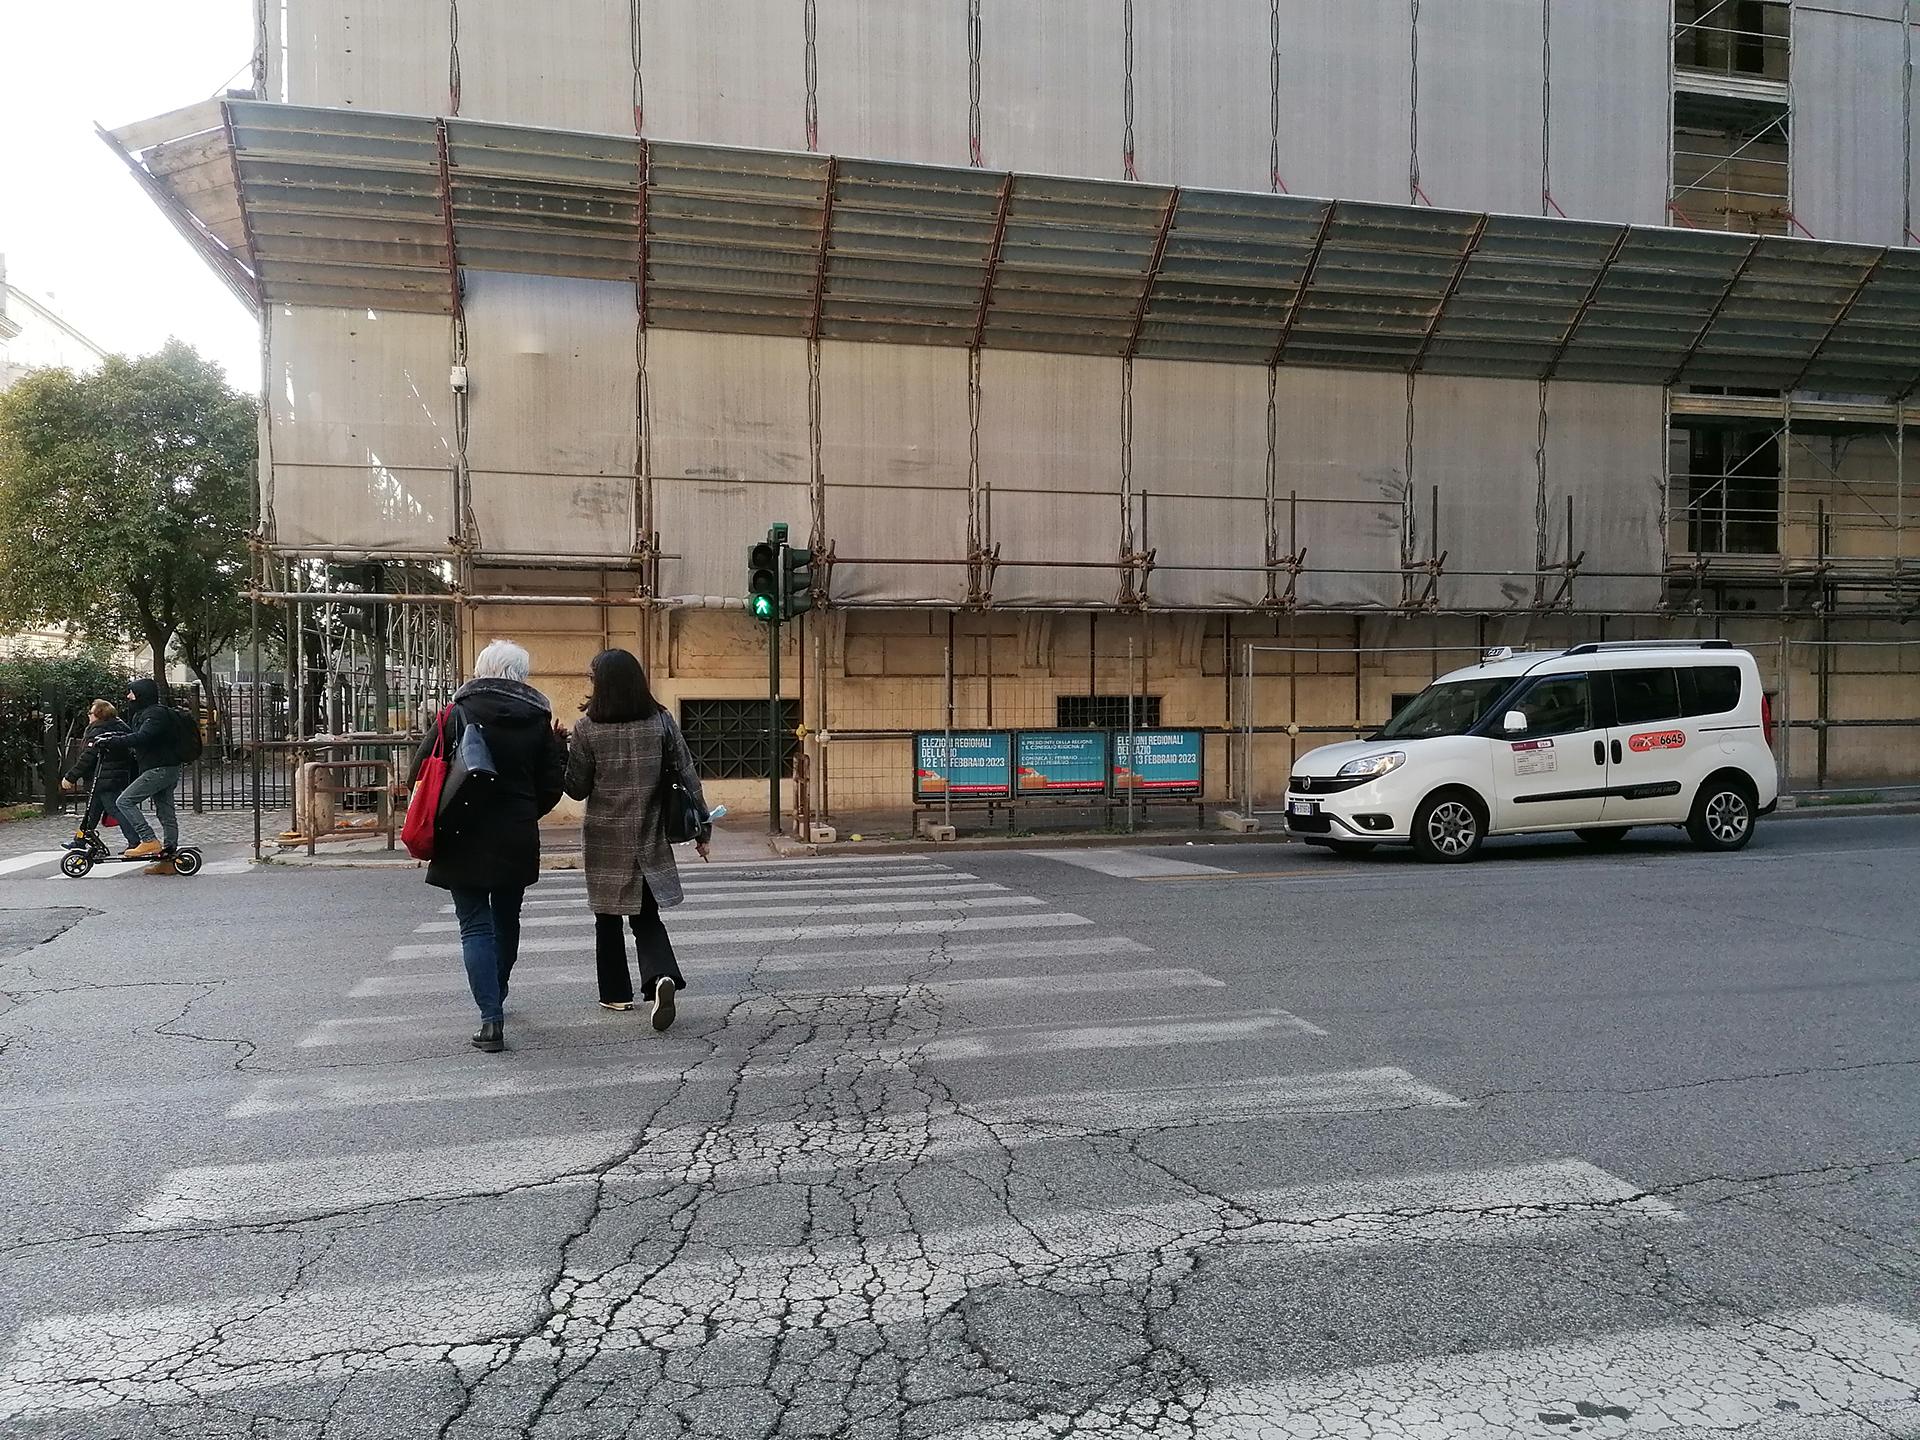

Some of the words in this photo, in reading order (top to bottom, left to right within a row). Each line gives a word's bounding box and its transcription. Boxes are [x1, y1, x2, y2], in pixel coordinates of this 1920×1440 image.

[921, 738, 954, 748] ELEZIOI
[954, 738, 992, 748] REGIONALI
[1117, 736, 1148, 746] ELEIONI
[1148, 735, 1184, 745] REGIONALI
[1660, 733, 1683, 745] 6645
[921, 748, 936, 758] DEL
[936, 748, 957, 758] LAIO
[1132, 745, 1152, 755] LAZIO
[922, 758, 932, 768] 12
[932, 758, 938, 767] E
[950, 758, 985, 768] FEBBRAIO
[985, 757, 1005, 767] 2023
[1118, 756, 1127, 765] 12
[1135, 755, 1144, 765] 13
[1144, 754, 1178, 765] FEBBRAIO
[1178, 754, 1196, 764] 2023
